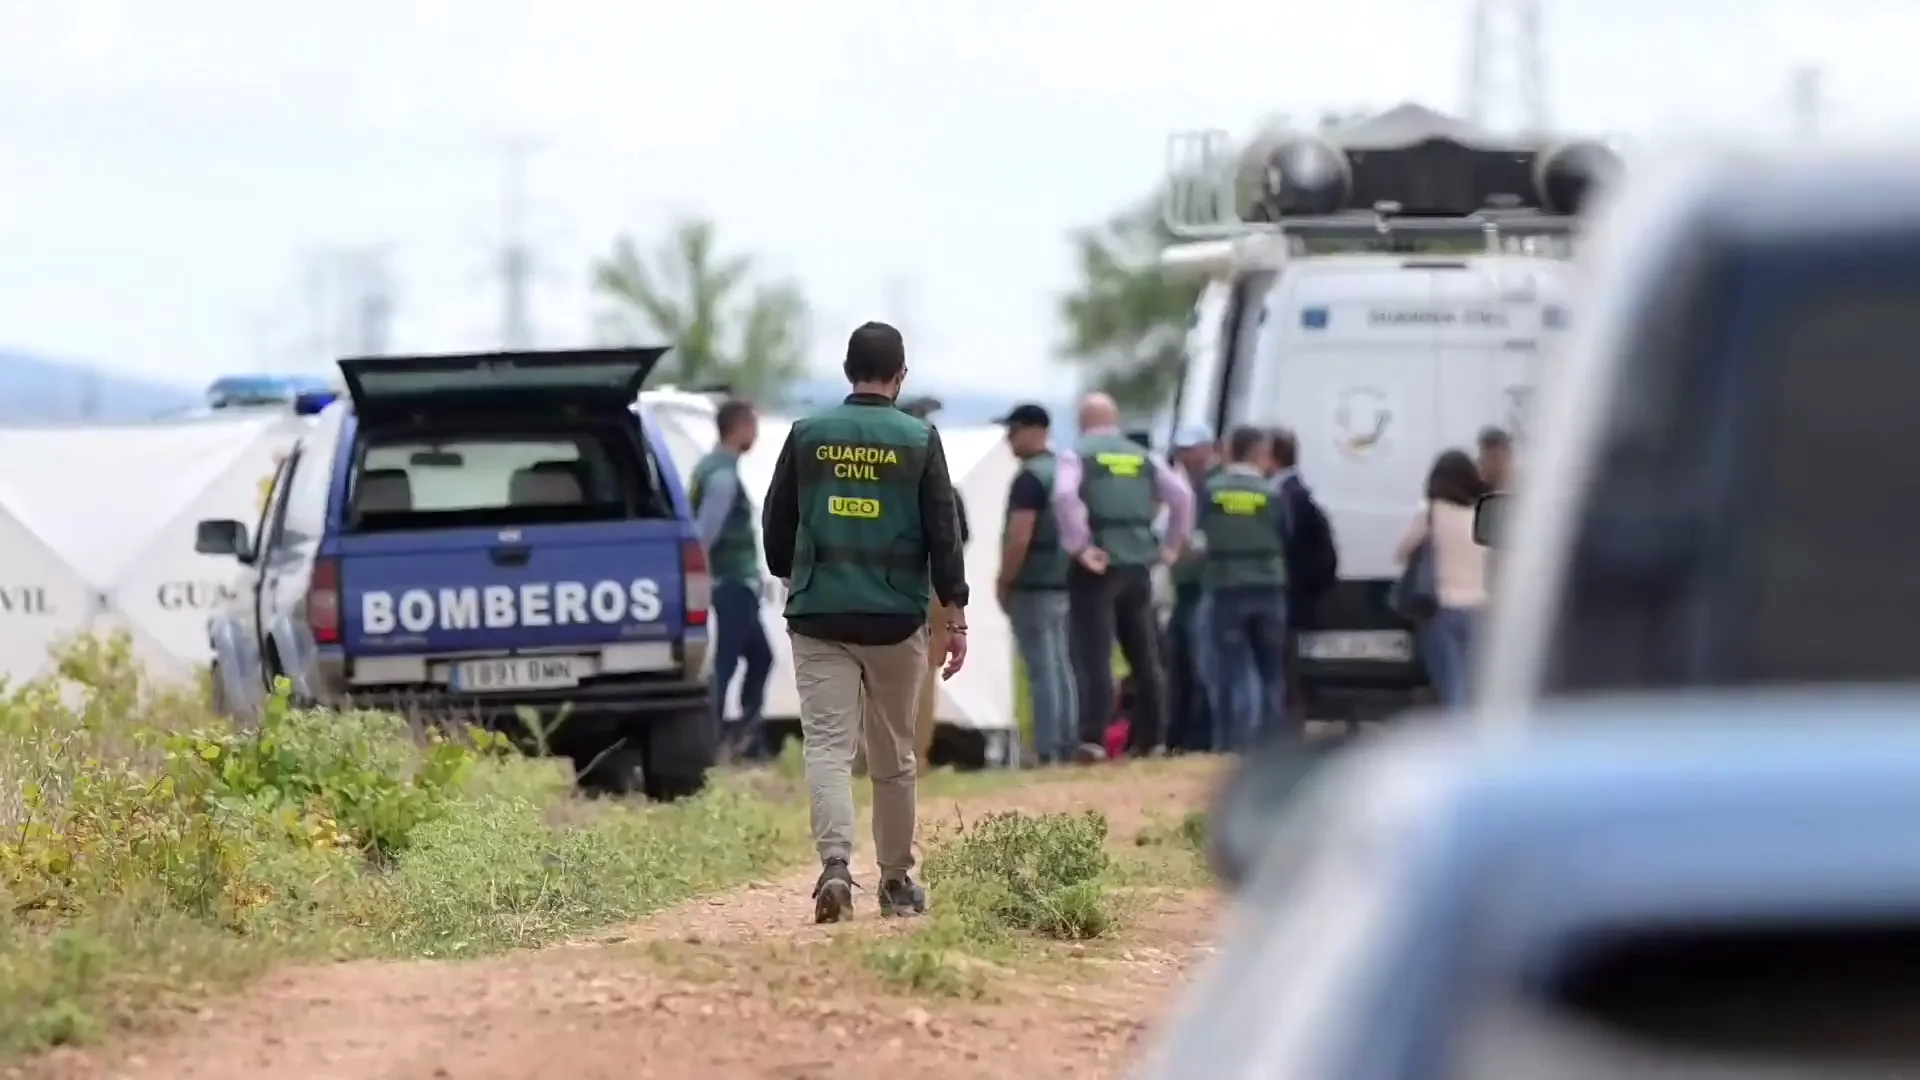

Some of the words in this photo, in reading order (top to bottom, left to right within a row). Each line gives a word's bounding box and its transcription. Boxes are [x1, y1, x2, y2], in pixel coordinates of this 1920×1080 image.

[816, 445, 898, 465] GUARDIA
[834, 463, 880, 481] CIVIL
[832, 499, 875, 514] UCO
[362, 577, 663, 634] BOMBEROS
